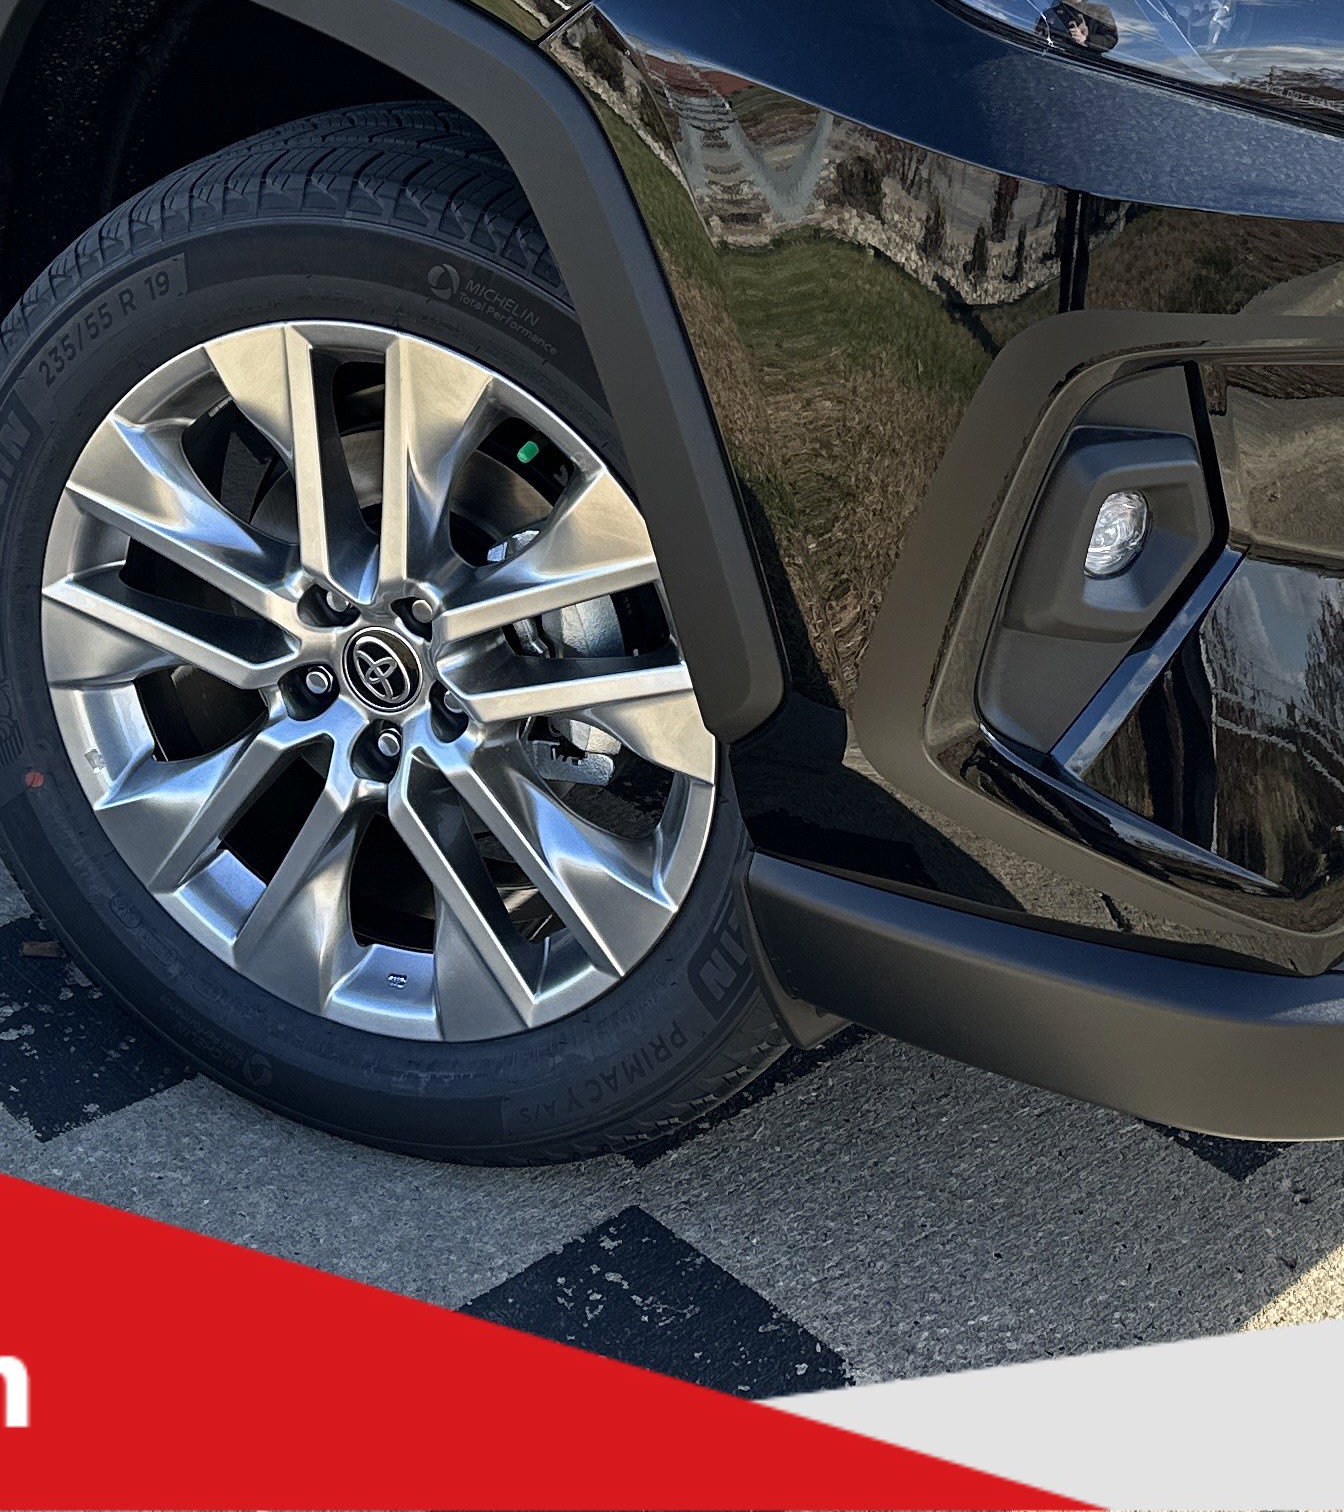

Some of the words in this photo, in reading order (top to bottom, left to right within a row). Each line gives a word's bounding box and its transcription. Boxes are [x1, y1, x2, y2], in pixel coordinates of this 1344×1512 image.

[38, 302, 113, 387] 235/55
[119, 288, 137, 316] R
[144, 270, 170, 301] 19
[459, 292, 485, 312] Total
[486, 306, 559, 356] Performance
[466, 279, 541, 327] MICHELIN
[567, 1019, 688, 1113] PRIMACY
